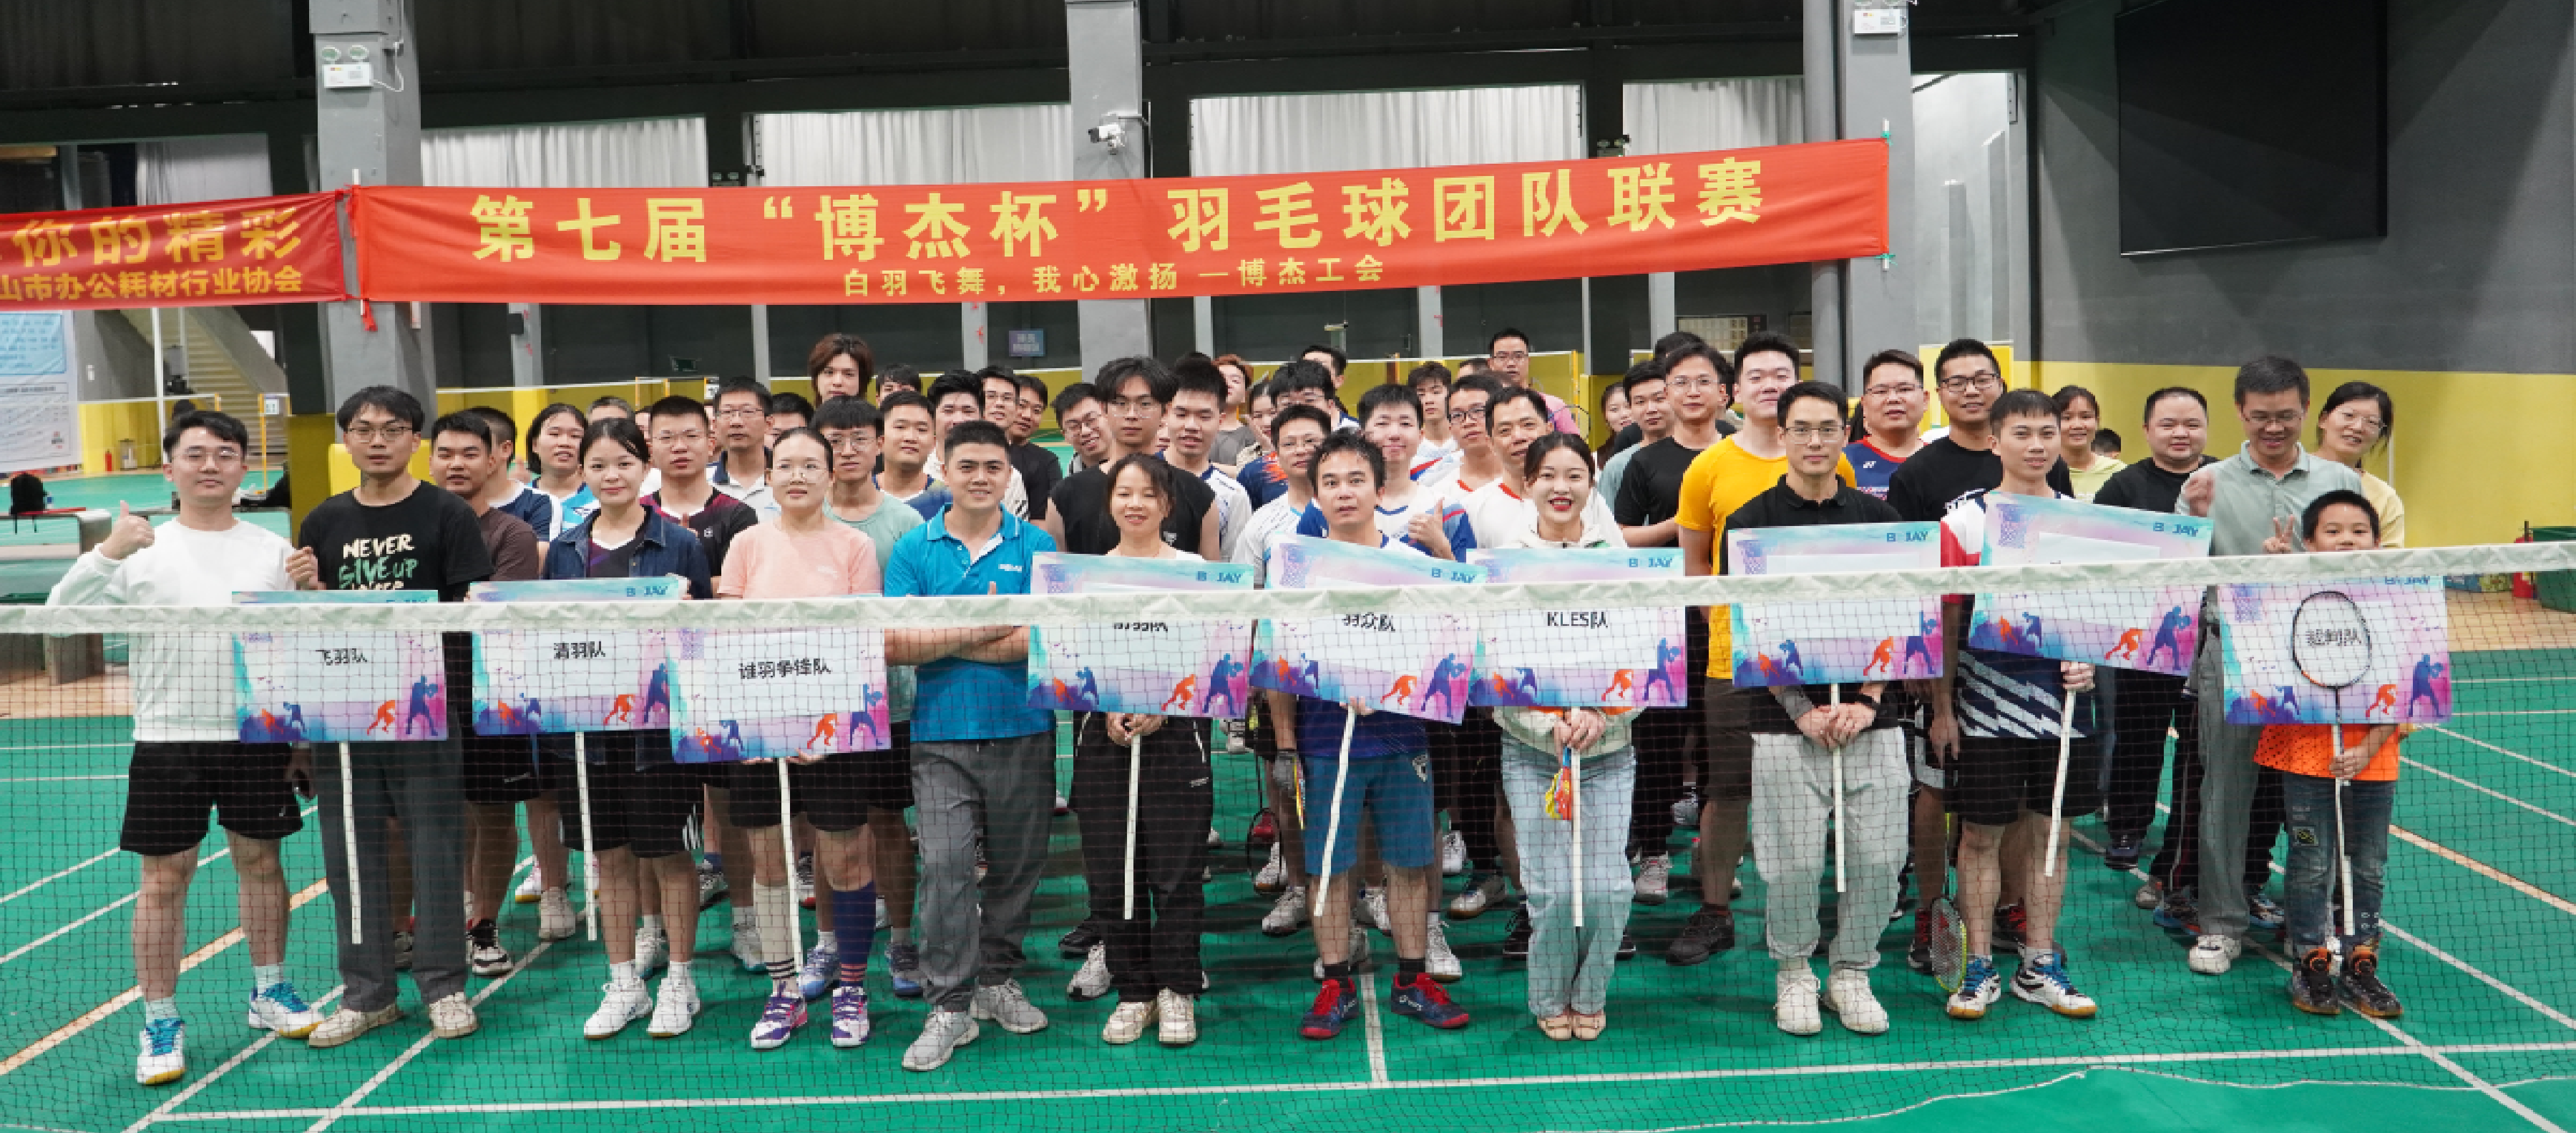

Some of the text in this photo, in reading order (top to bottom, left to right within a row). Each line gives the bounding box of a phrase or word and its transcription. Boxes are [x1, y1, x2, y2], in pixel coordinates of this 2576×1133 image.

[343, 533, 416, 559] NEVER
[339, 555, 419, 589] GIVE UP
[1547, 611, 1608, 628] KLES队
[316, 647, 368, 666] 飞羽队
